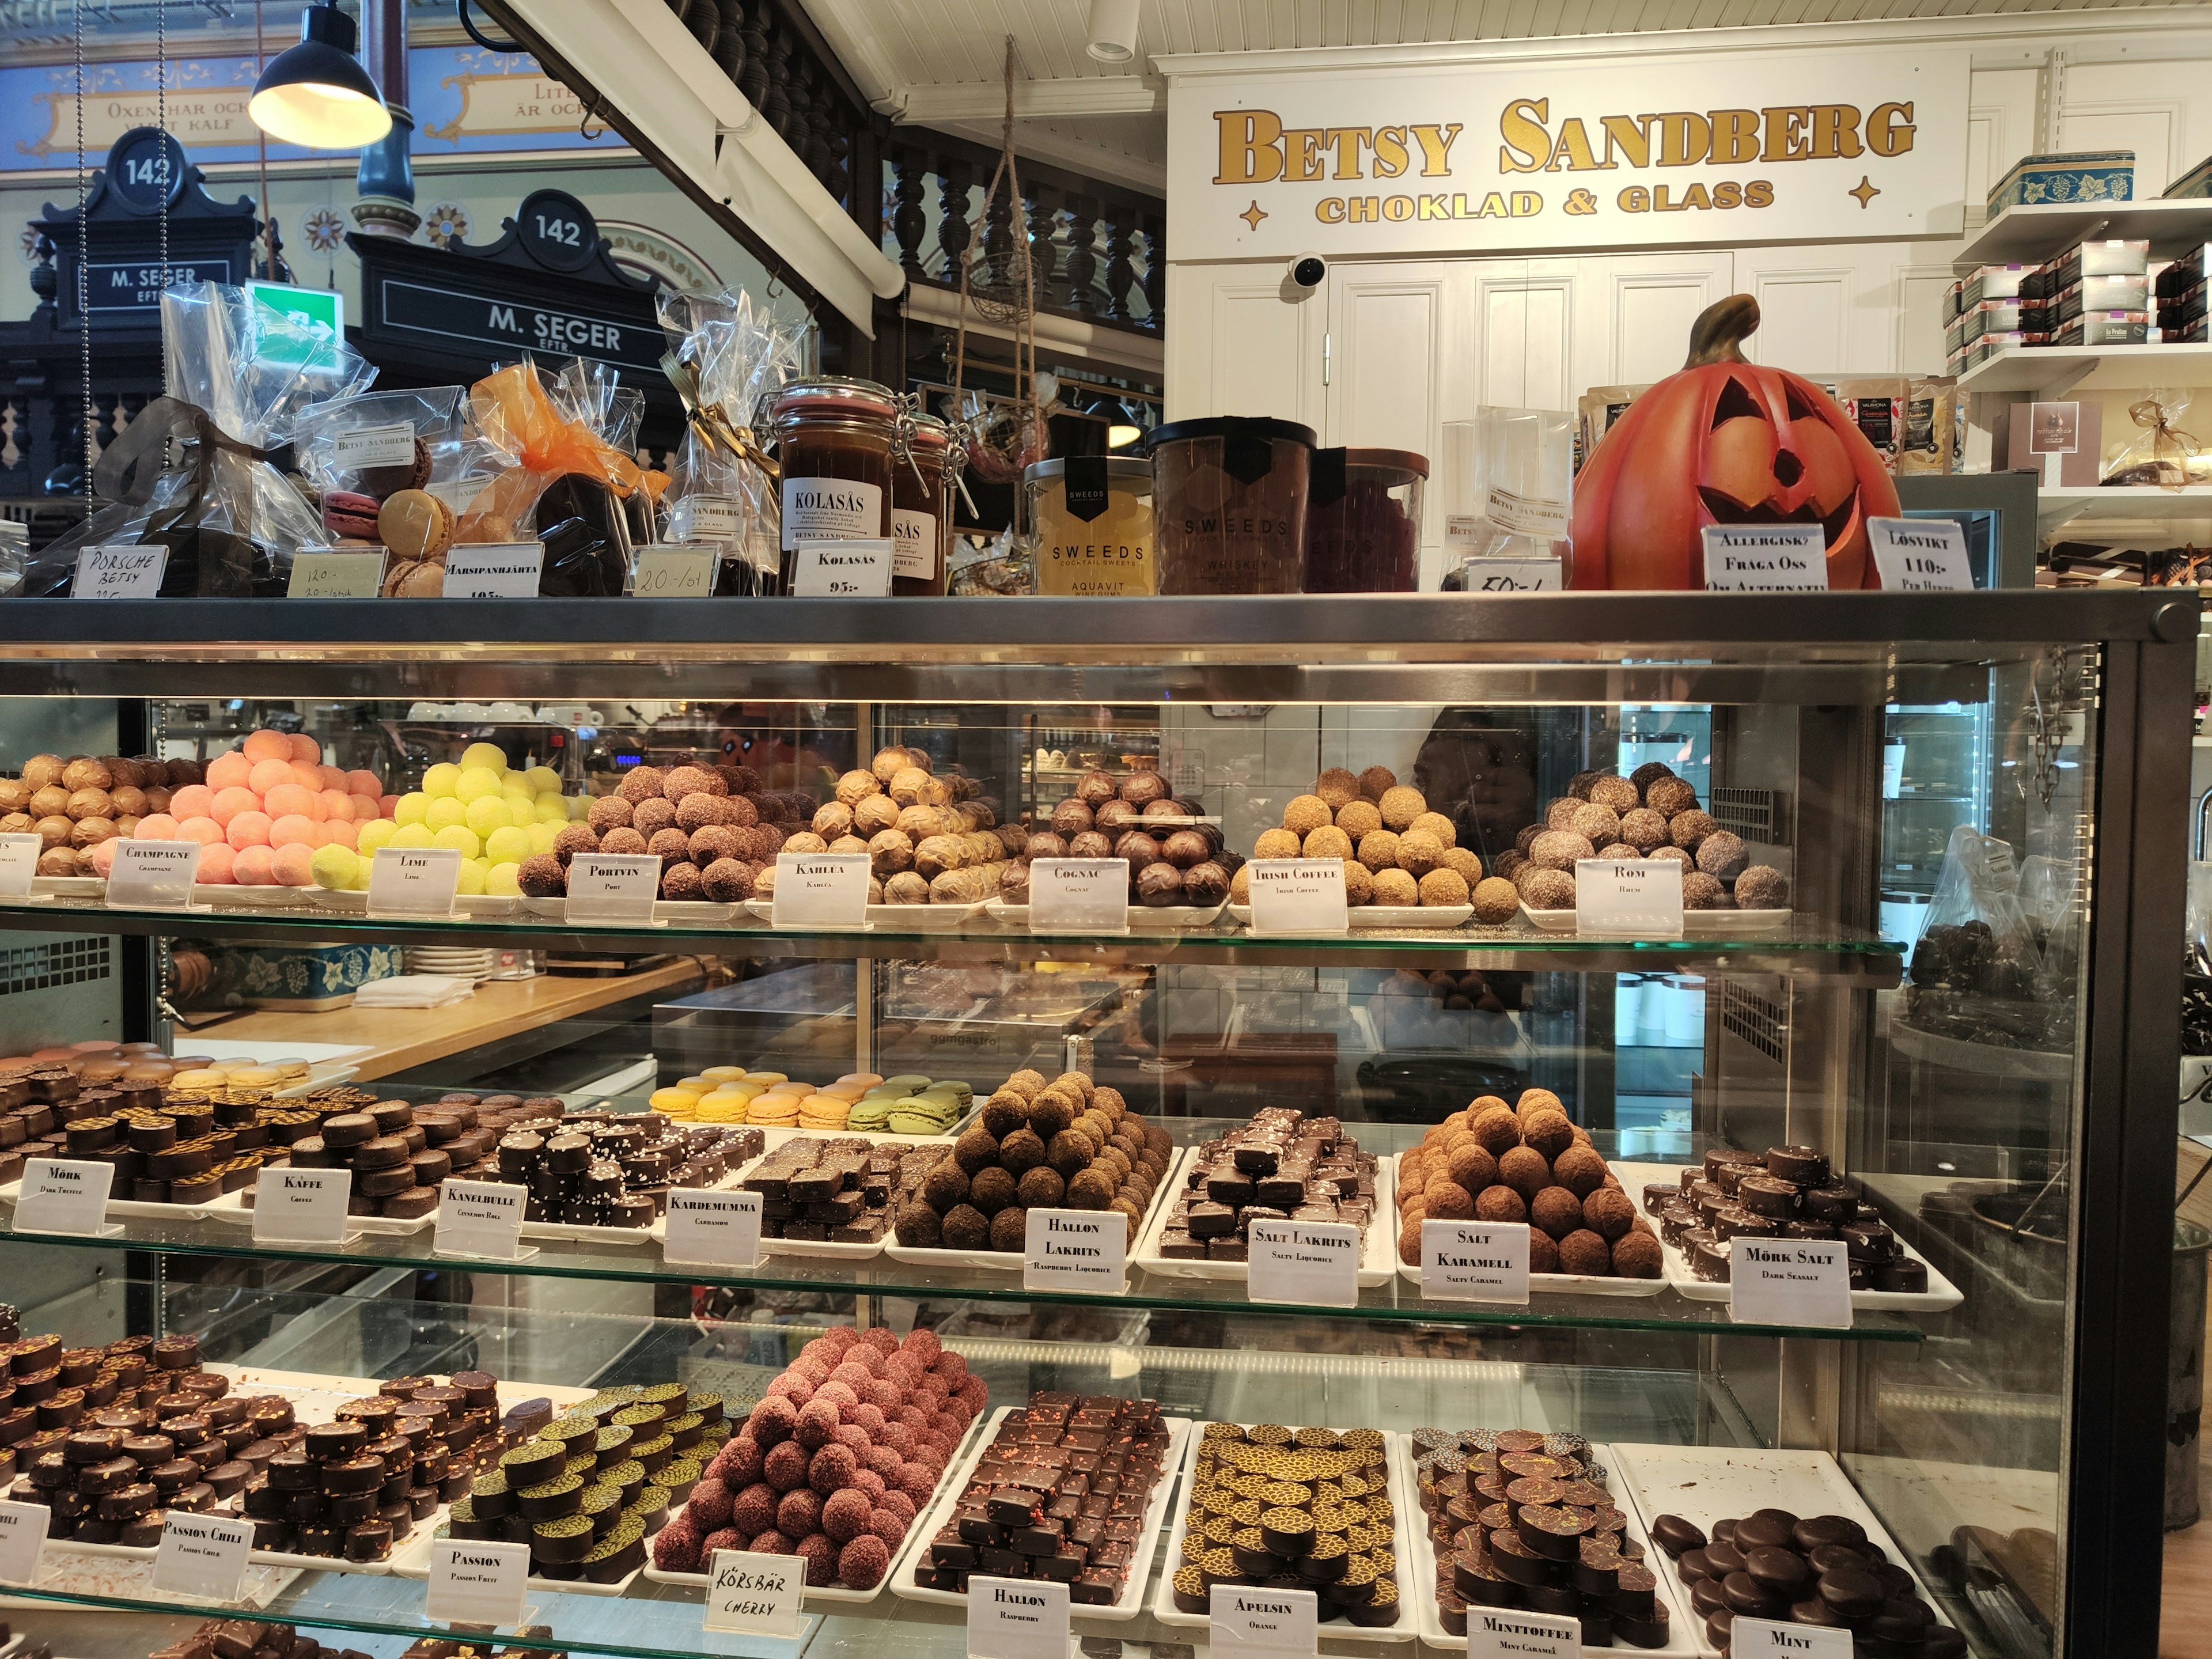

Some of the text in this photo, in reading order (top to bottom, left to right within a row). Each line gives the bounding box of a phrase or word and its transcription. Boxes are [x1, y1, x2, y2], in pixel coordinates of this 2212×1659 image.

[108, 102, 160, 119] OXEN
[168, 103, 205, 115] HAR
[516, 103, 541, 116] ÄR
[189, 119, 233, 131] KALF
[1213, 97, 1917, 185] BETSY SANDBERG
[125, 158, 171, 185] 142
[1315, 180, 1775, 224] CHOKLAD & GLASS
[536, 215, 581, 248] 142
[111, 268, 196, 287] M. SEGER
[488, 305, 622, 352] M. SEGER
[539, 338, 574, 354] EFTR.
[368, 436, 411, 447] SANDBERG
[1070, 490, 1104, 499] SWEEDS
[795, 491, 864, 513] KOLASÅS
[1490, 494, 1565, 520] BETSY SANDBERG
[1184, 518, 1287, 536] SWEEDS
[1719, 533, 1809, 547] ALLERGISK?
[1888, 529, 1949, 550] LÖSVIKT
[817, 552, 876, 566] KOLASÅS
[1052, 545, 1143, 560] SWEEDS
[89, 550, 156, 571] PORSCHE
[1725, 556, 1807, 571] FRÅGA OSS
[1905, 557, 1946, 575] 110:-
[98, 571, 141, 585] BETSY
[830, 581, 859, 593] 95:-
[1071, 582, 1124, 592] AQUAVIT
[126, 846, 191, 859] CHAMPAGNE
[138, 864, 172, 872] CHAMPAGNE
[399, 855, 429, 868] LIME
[589, 865, 639, 877] PORTVIN
[795, 863, 845, 875] KAHLÚA
[1054, 866, 1101, 879] COGNAC
[1255, 867, 1338, 880] IRISH COFFEE
[1613, 866, 1646, 878] ROM
[1619, 885, 1641, 893] RHUM
[929, 1034, 997, 1046] ggmgastro
[47, 1166, 82, 1180] MÖRK
[283, 1176, 323, 1189] KAFFE
[40, 1185, 83, 1195] DARK TRUFFLE
[290, 1195, 313, 1203] COFFEE
[447, 1188, 516, 1207] KANELBULLE
[670, 1196, 756, 1213] KARDEMUMMA
[486, 1211, 502, 1220] ROLL
[695, 1217, 729, 1226] CARDAMOM
[1047, 1218, 1100, 1233] HALLON
[1255, 1228, 1351, 1249] SALT LAKRITS
[1457, 1230, 1491, 1244] SALT
[1045, 1241, 1101, 1257] LAKRITS
[1745, 1247, 1835, 1265] MÖRK SALT
[1271, 1250, 1334, 1263] SALTY LIQUORICE
[1436, 1252, 1513, 1269] KARAMELL
[1033, 1262, 1111, 1274] RASPBERRY LIQUORICE
[1446, 1274, 1504, 1285] SALTY CARAMEL
[1762, 1270, 1819, 1281] DARK SEASALT
[162, 1521, 242, 1544] PASSION CHILI
[178, 1544, 202, 1555] PASSION
[450, 1551, 502, 1567] PASSION
[450, 1572, 498, 1584] PASSION FRUIT
[715, 1566, 786, 1592] KÖRSBÄR
[994, 1588, 1046, 1607] HALLON
[724, 1600, 776, 1616] CHERRY
[1234, 1597, 1293, 1614] APELSIN
[999, 1611, 1040, 1623] RASPBERRY
[1249, 1620, 1278, 1630] ORANGE
[1482, 1616, 1574, 1641] MINTTOFFEE
[1770, 1630, 1813, 1649] MINT
[1499, 1640, 1558, 1655] MINT CARAMEL
